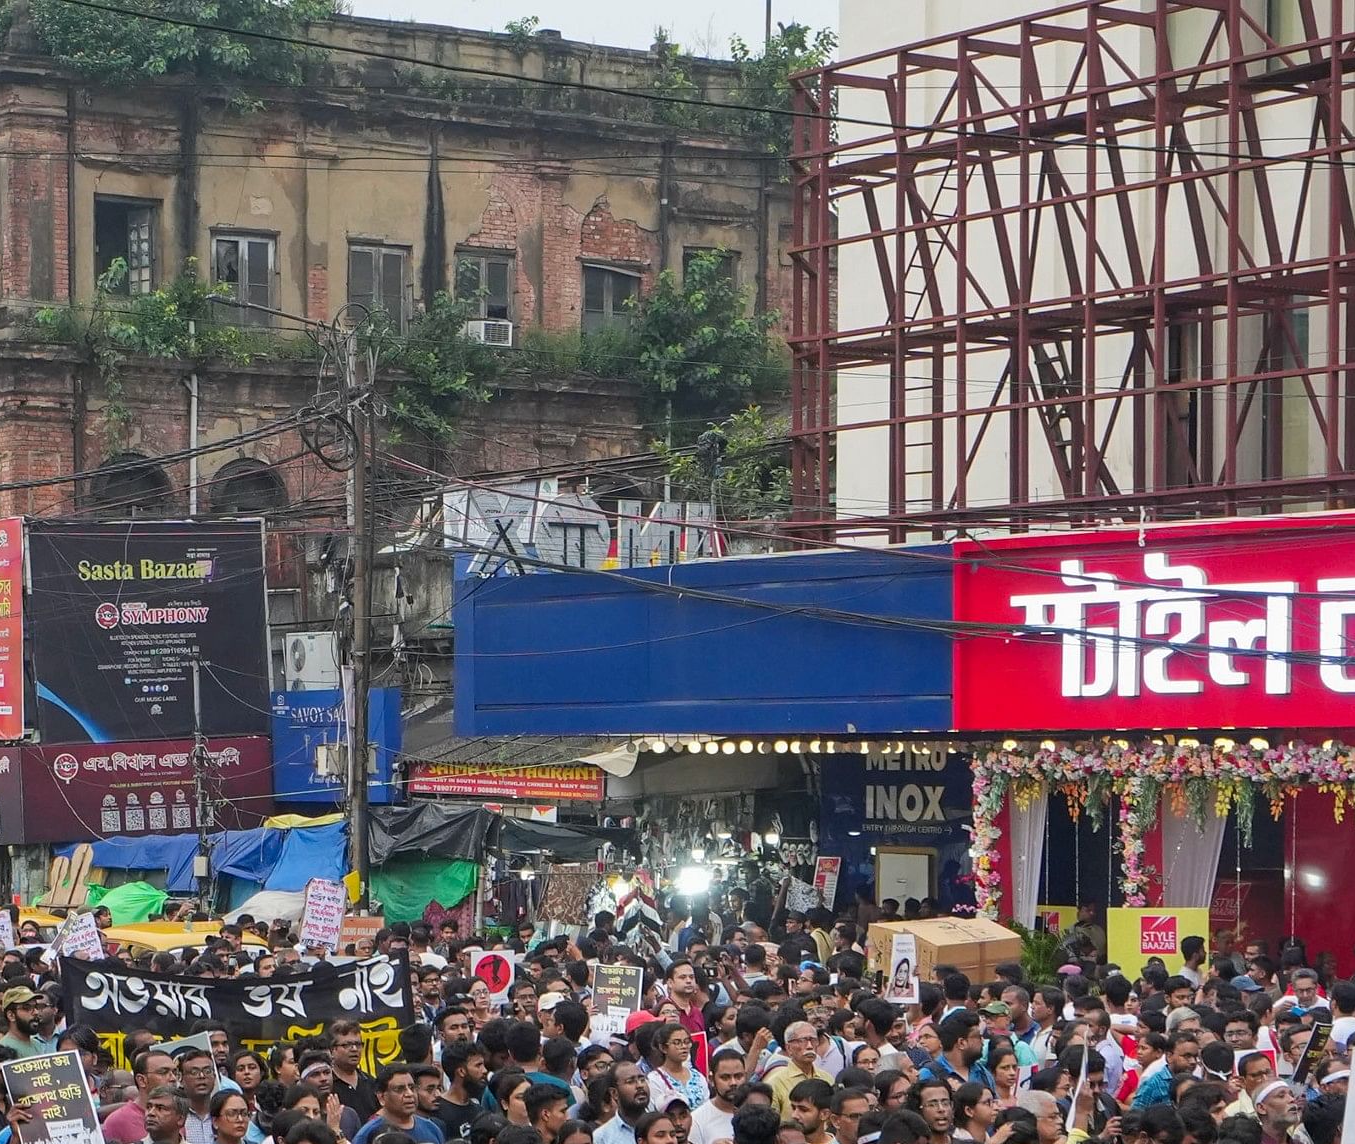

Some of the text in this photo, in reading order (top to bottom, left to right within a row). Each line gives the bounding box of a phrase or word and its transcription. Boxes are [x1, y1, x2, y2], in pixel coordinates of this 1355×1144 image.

[78, 560, 134, 581] Sasta
[121, 607, 210, 625] SYMPHONY
[291, 706, 325, 724] SAVOY
[866, 748, 948, 771] METRO
[865, 783, 946, 822] INOX
[862, 824, 883, 832] ENTRY
[1143, 931, 1175, 942] STYLE
[1142, 942, 1176, 950] BAAZAR
[81, 954, 405, 1019] অভয়ার ভয় নাই
[11, 1055, 70, 1074] অভয়ার ভয়
